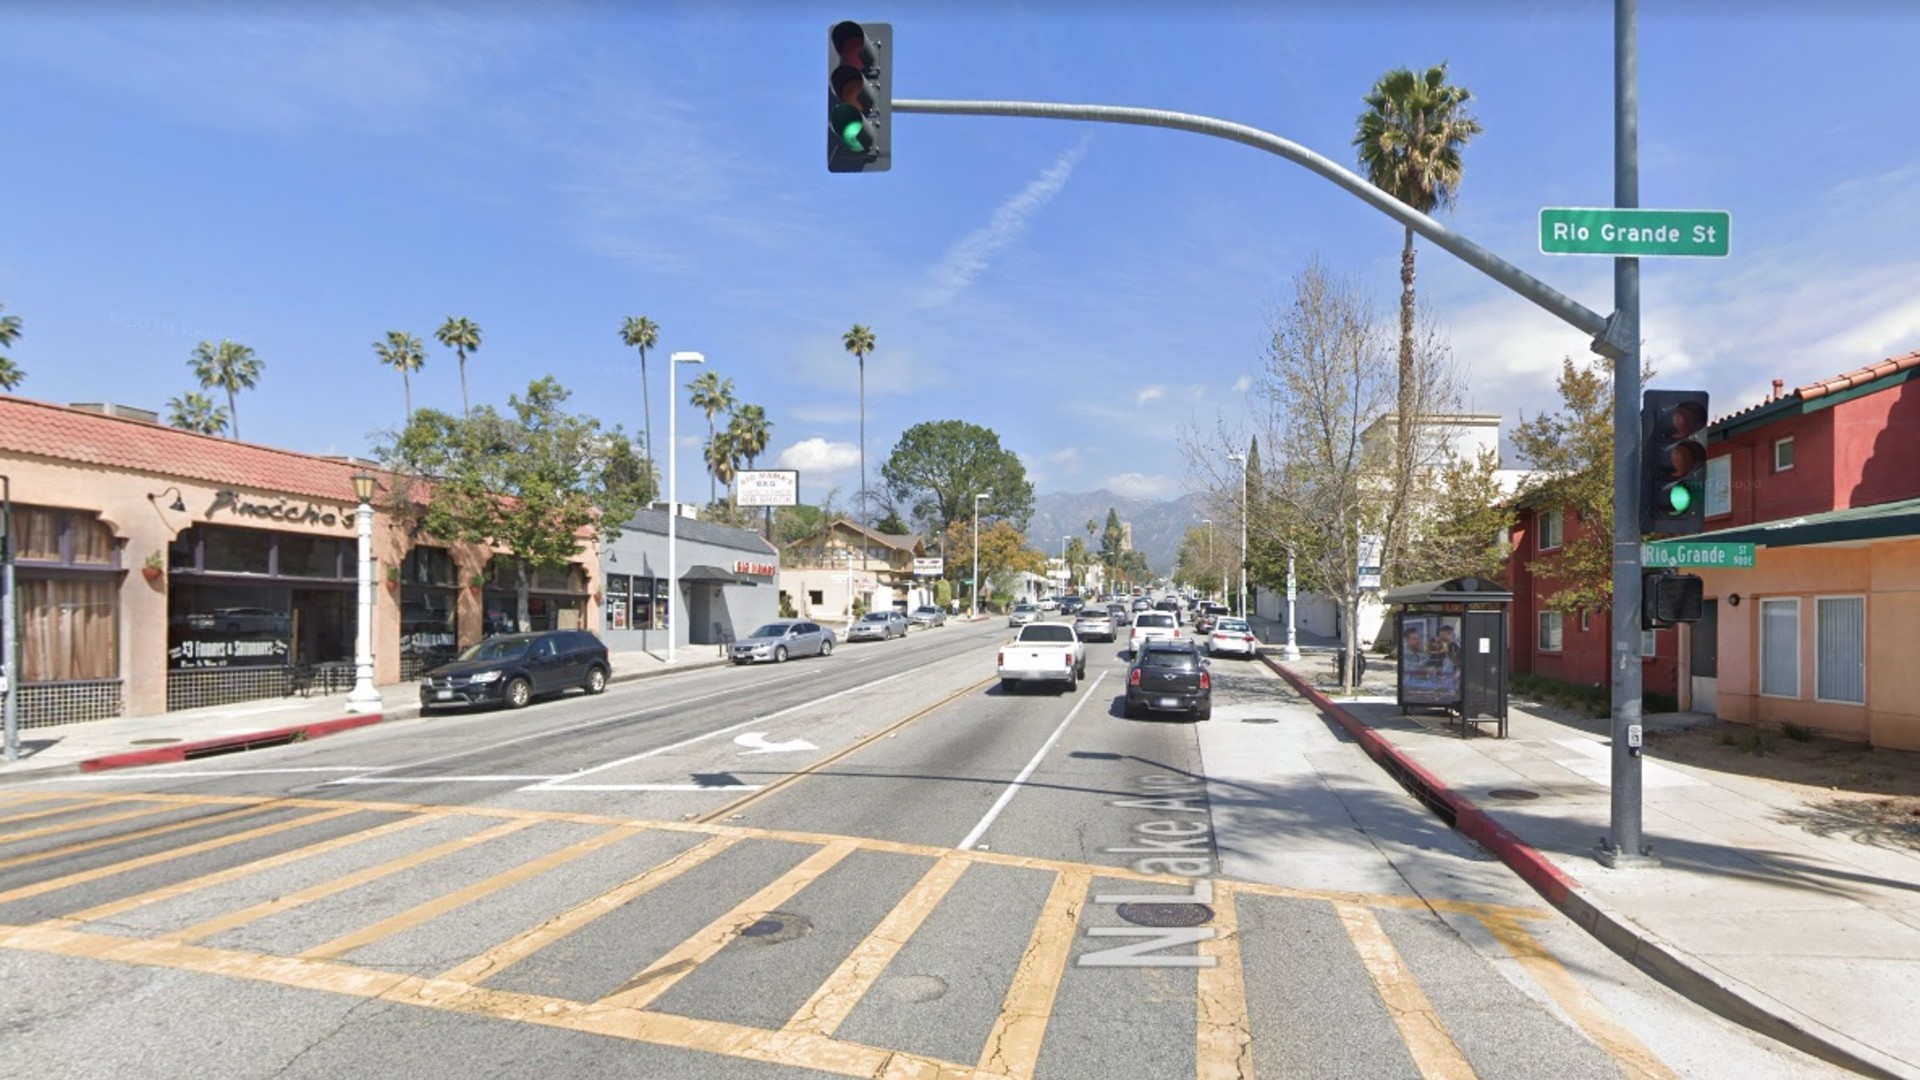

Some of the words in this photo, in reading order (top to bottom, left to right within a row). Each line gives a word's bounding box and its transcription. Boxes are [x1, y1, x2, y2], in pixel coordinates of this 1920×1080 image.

[1553, 222, 1589, 241] Rio
[1601, 223, 1680, 243] Grande
[1692, 225, 1716, 243] St
[1646, 545, 1668, 563] Rio
[1677, 545, 1725, 563] Grande
